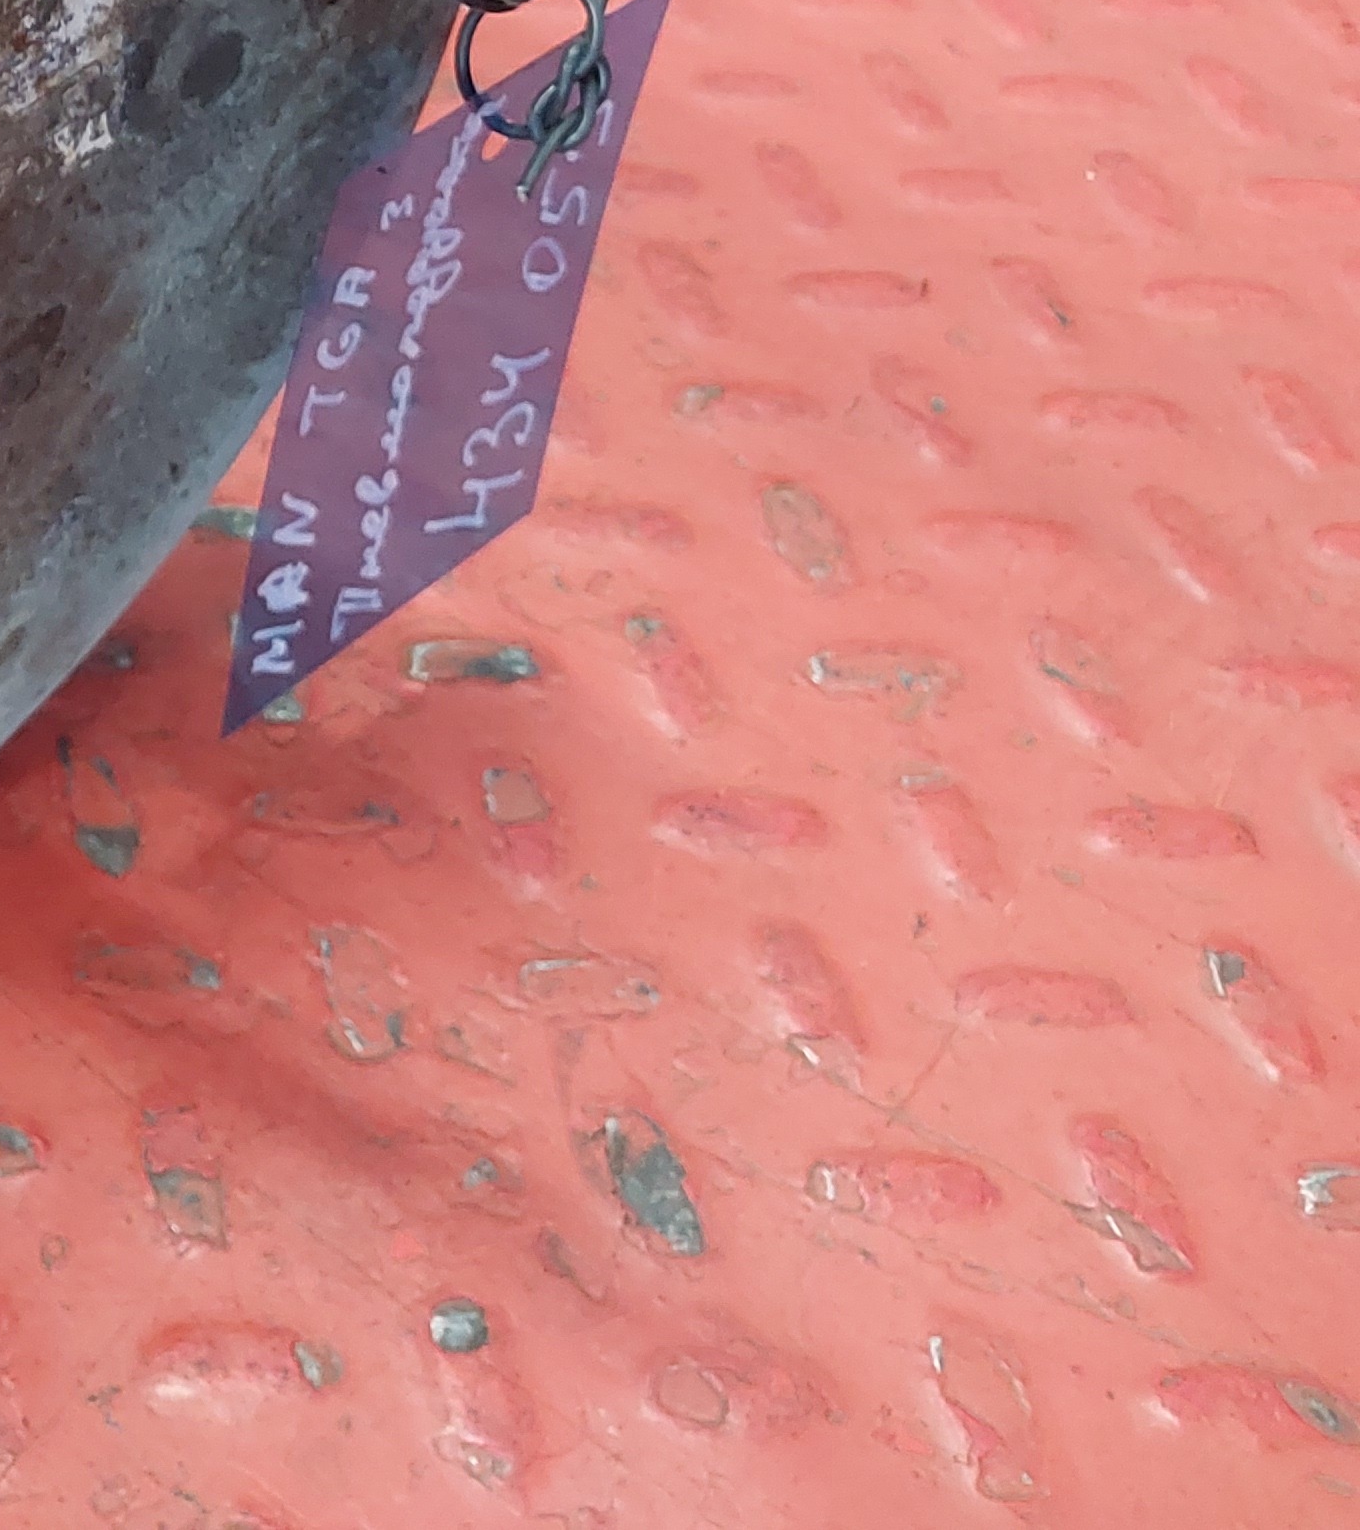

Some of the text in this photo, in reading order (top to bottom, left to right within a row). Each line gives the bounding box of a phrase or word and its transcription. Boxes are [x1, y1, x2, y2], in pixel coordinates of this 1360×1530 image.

[250, 496, 320, 677] MAN
[300, 264, 377, 437] TGA
[423, 345, 551, 535] 434
